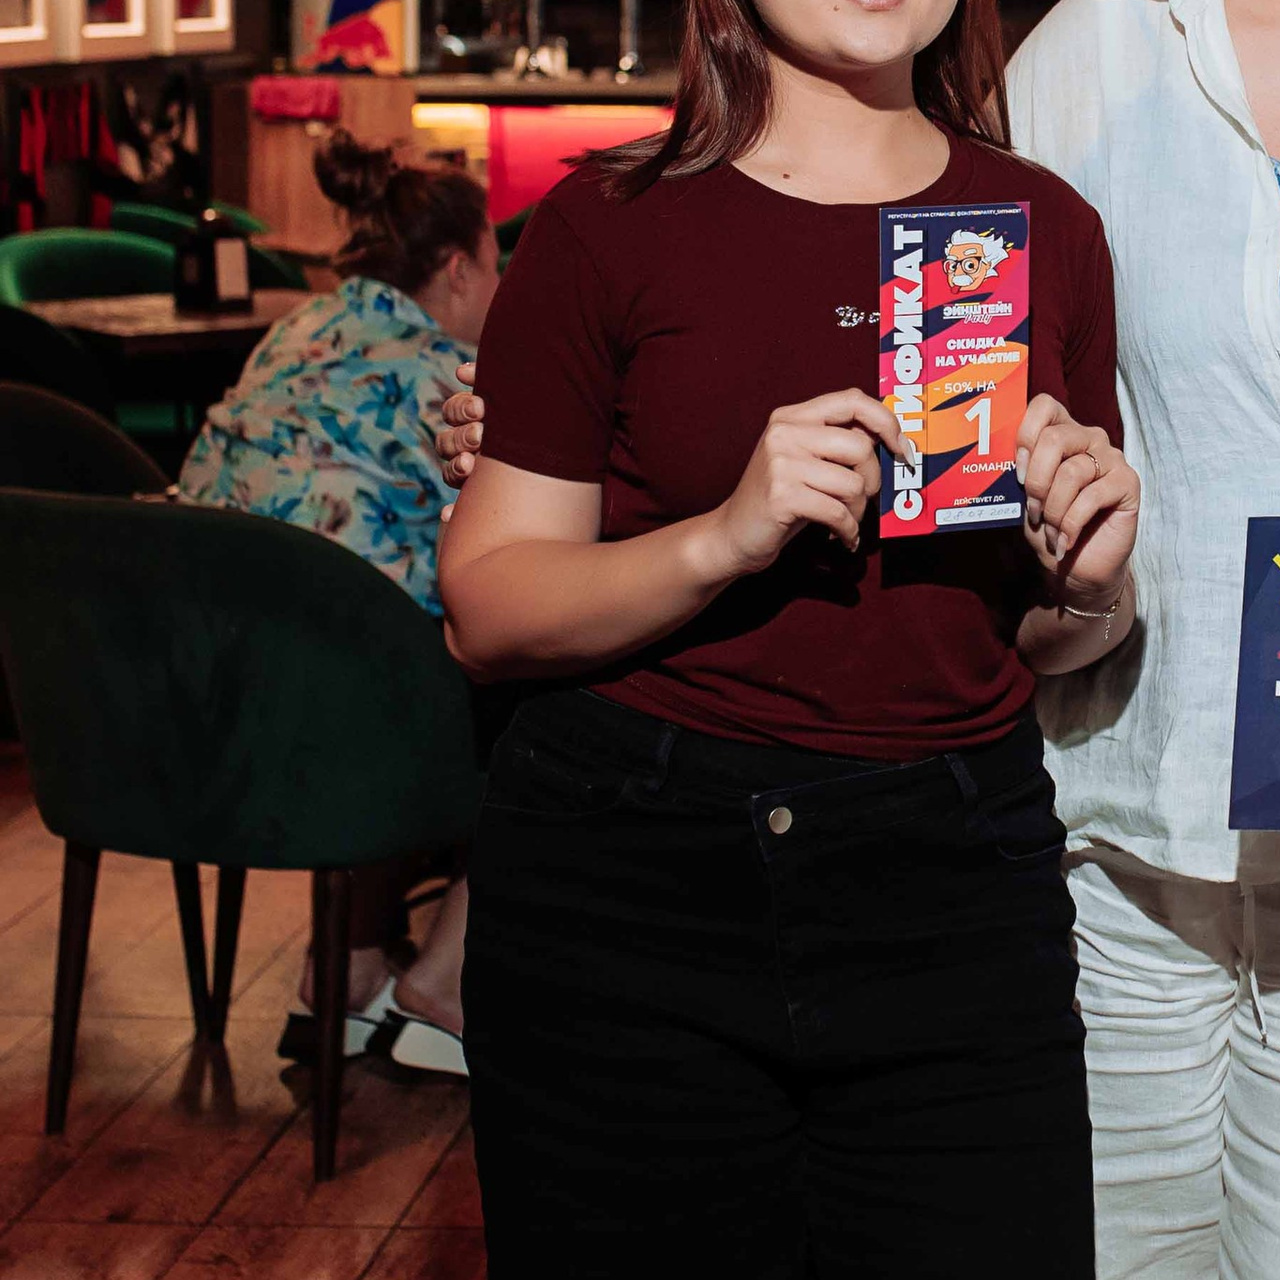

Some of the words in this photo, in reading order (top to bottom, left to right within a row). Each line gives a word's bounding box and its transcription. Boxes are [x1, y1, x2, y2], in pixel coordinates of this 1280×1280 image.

[946, 336, 1006, 350] СКИДКА
[935, 355, 956, 367] НА
[958, 351, 1021, 366] УЧАСТИЕ
[944, 382, 974, 393] 50%
[976, 380, 996, 391] НА
[964, 397, 991, 456] 1
